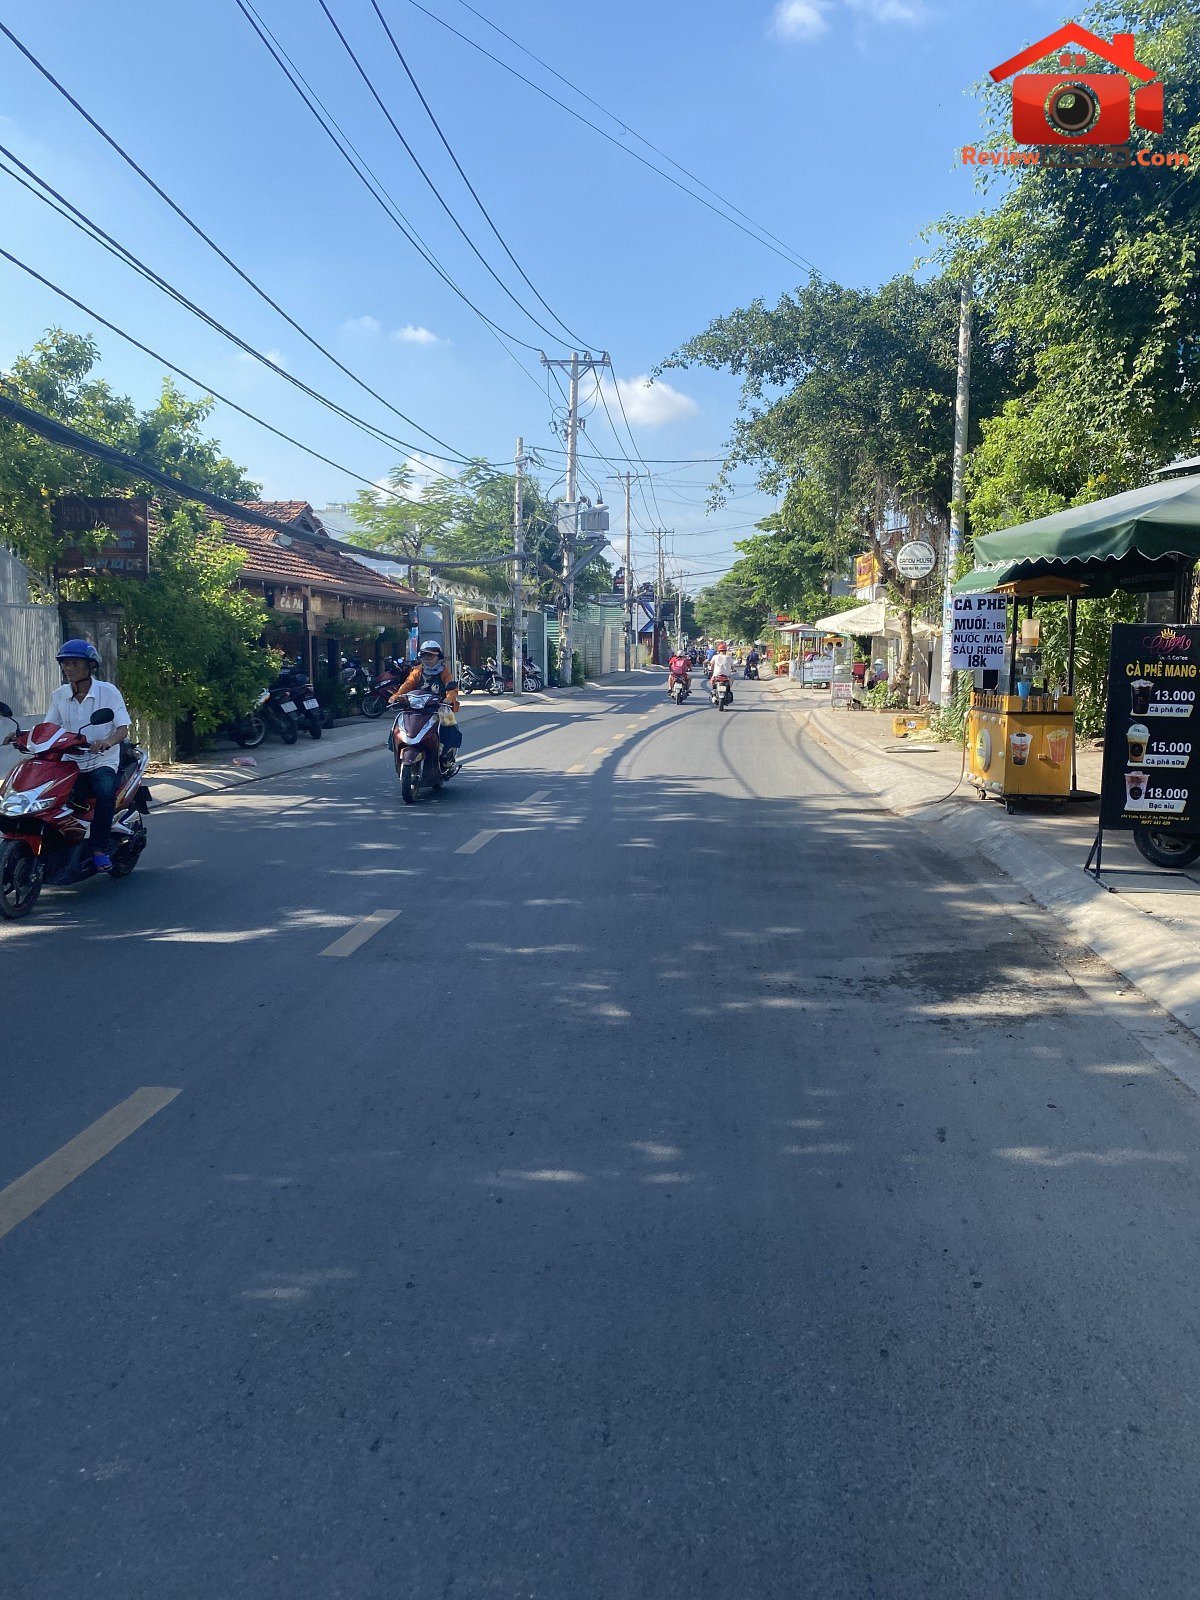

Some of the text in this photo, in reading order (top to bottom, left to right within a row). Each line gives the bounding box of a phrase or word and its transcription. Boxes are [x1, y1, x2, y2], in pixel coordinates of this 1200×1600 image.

[954, 595, 1006, 611] CÀ PHÊ
[983, 633, 1003, 644] MÍA
[977, 644, 1004, 655] RIÊNG
[1126, 661, 1141, 676] CÀ
[1144, 661, 1163, 678] PHÊ
[1164, 664, 1197, 678] MANG
[1154, 690, 1196, 702] 13.000
[1175, 706, 1189, 714] đen
[1151, 741, 1192, 753] 15.000
[1148, 787, 1189, 799] 18.000
[1148, 802, 1163, 810] Bạc
